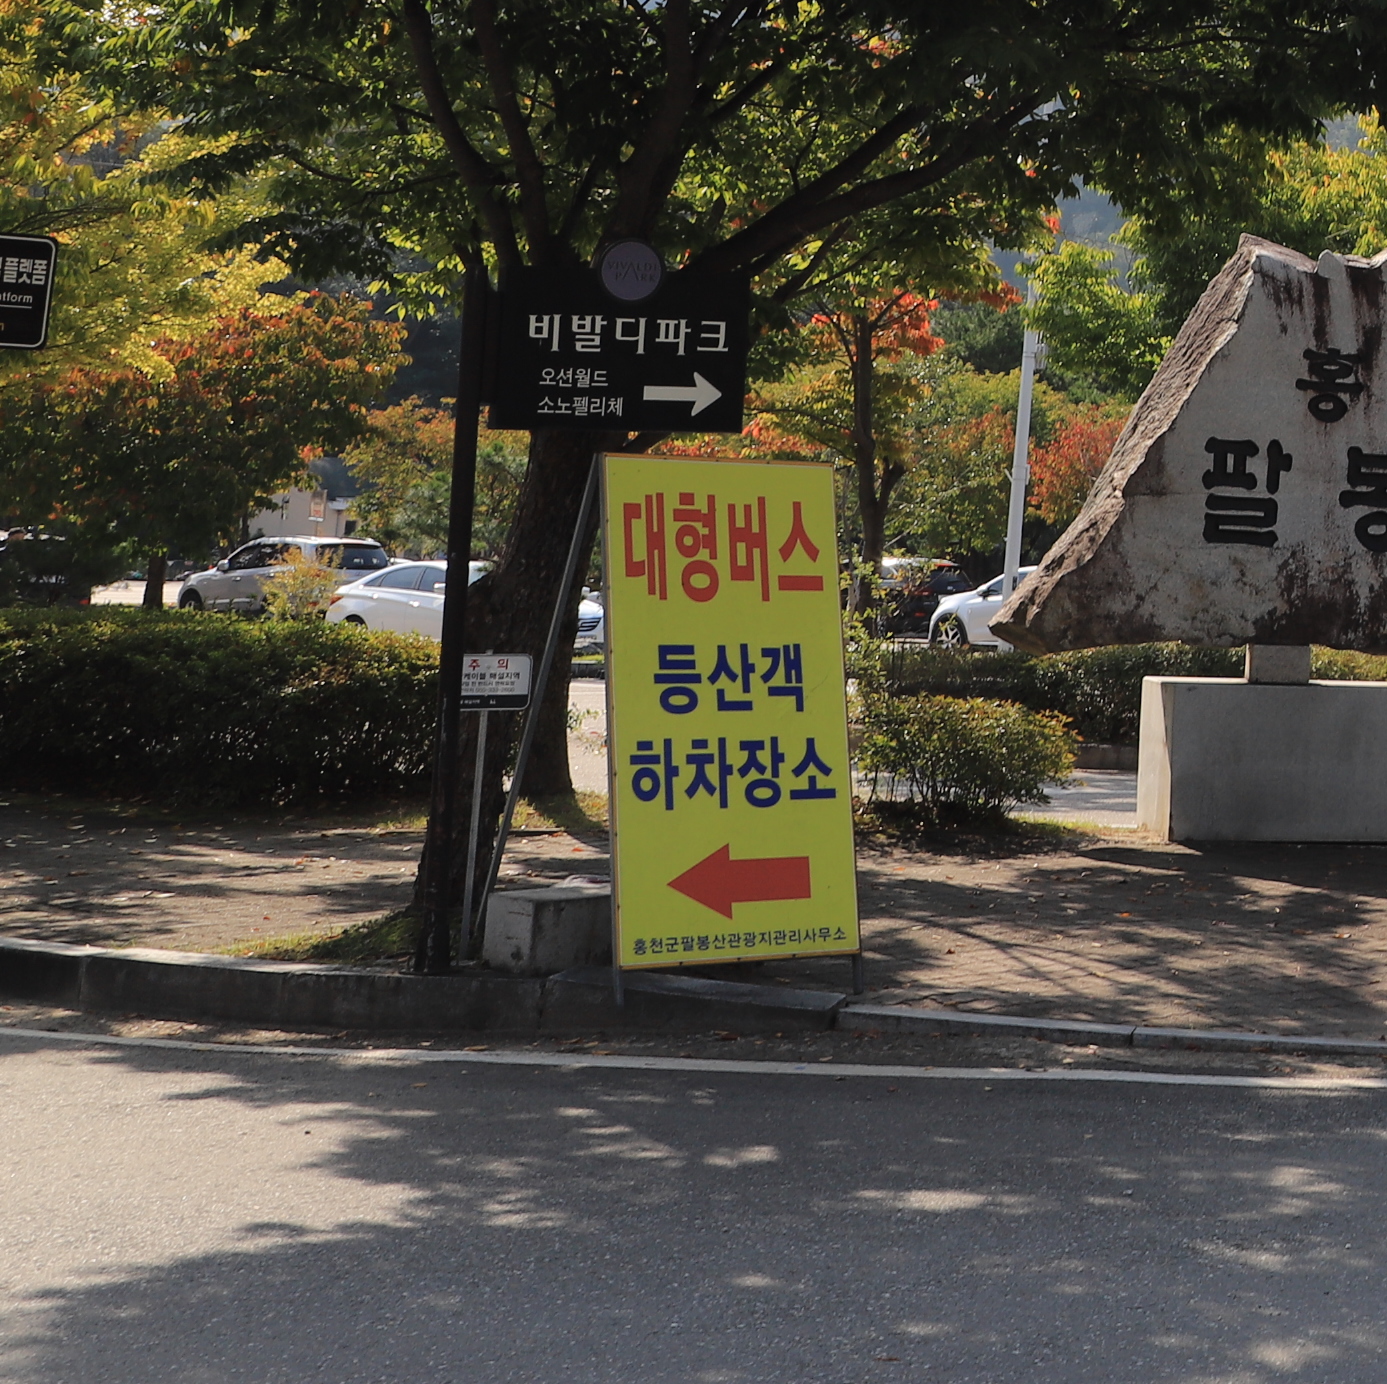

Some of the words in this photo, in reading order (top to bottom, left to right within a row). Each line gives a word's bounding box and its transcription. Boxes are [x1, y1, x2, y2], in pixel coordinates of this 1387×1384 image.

[0, 257, 48, 285] 플렛폼
[528, 314, 729, 355] 비발디파크
[539, 368, 609, 388] 오션월드
[537, 396, 624, 417] 소노펠리체
[622, 492, 825, 603] 대형버스
[653, 642, 805, 714] 등산객
[629, 736, 837, 811] 하차장소
[633, 926, 847, 956] 홍천군팔봉산관광지관리사무소
